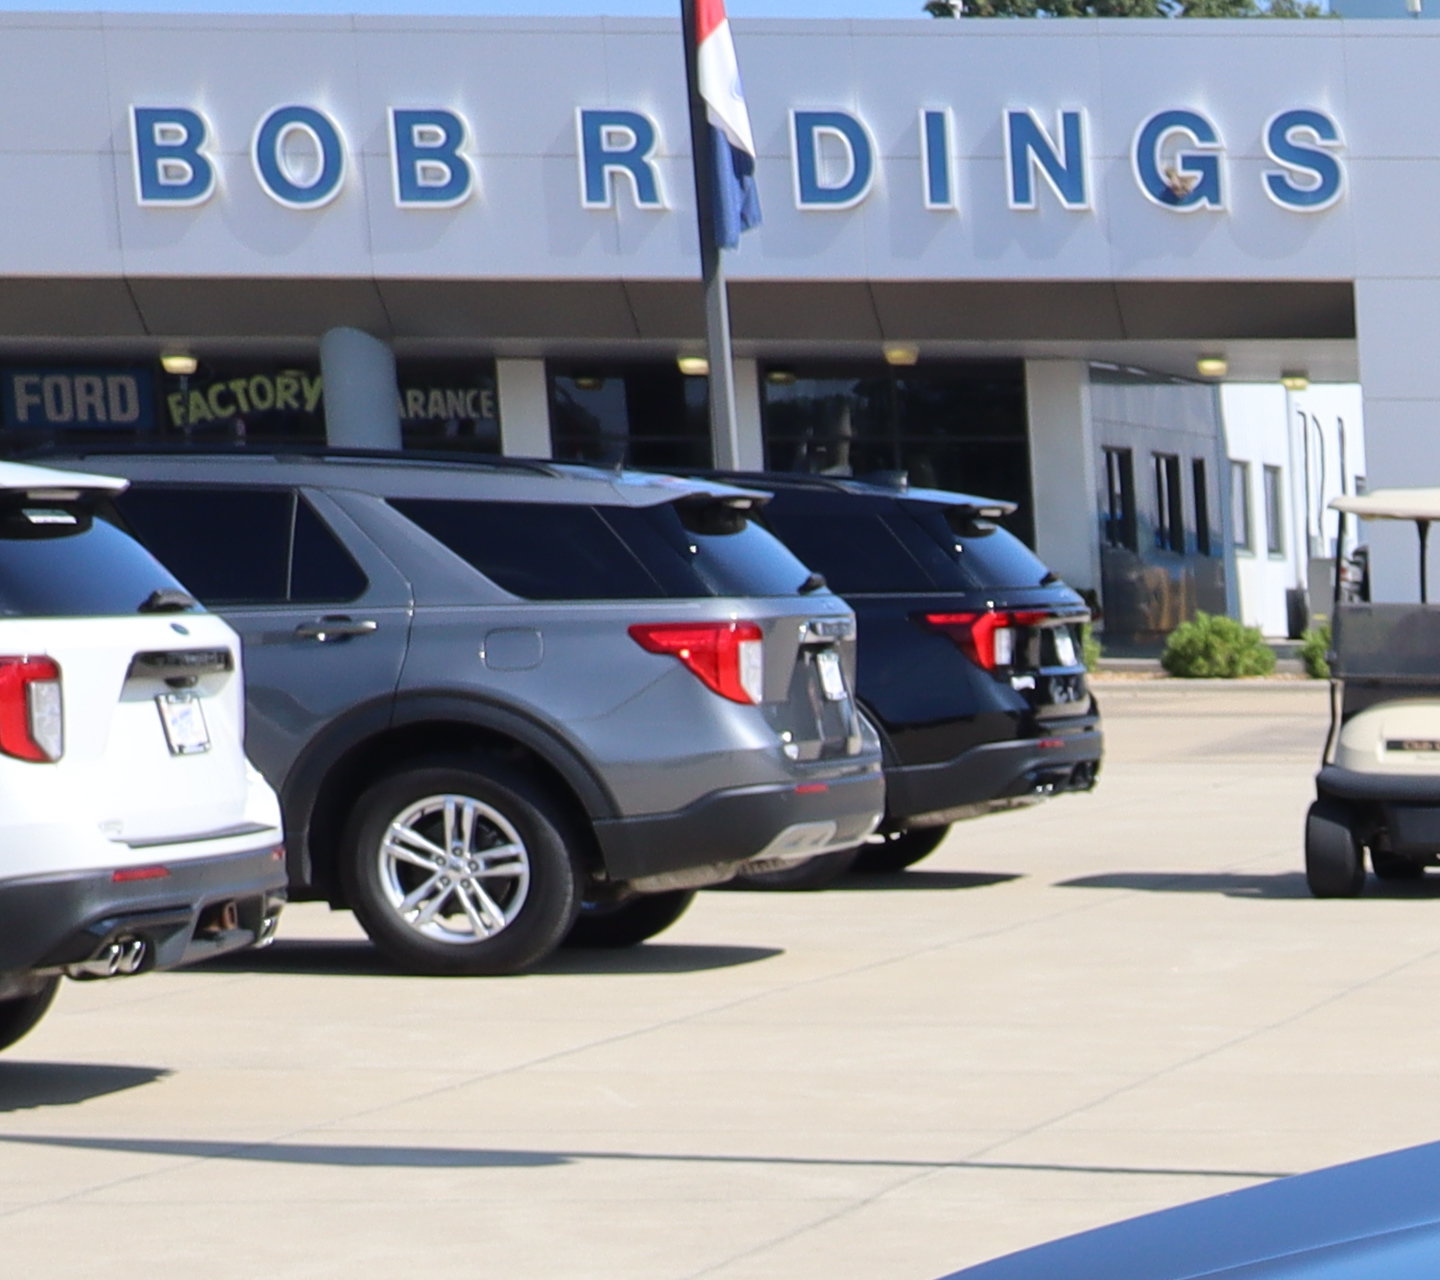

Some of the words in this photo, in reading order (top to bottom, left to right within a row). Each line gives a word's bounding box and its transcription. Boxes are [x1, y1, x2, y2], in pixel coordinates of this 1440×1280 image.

[129, 104, 476, 210] BOB
[576, 106, 1346, 213] RDINGS
[12, 374, 140, 424] FORD
[166, 374, 322, 428] FACTORY
[400, 388, 494, 420] RANCE
